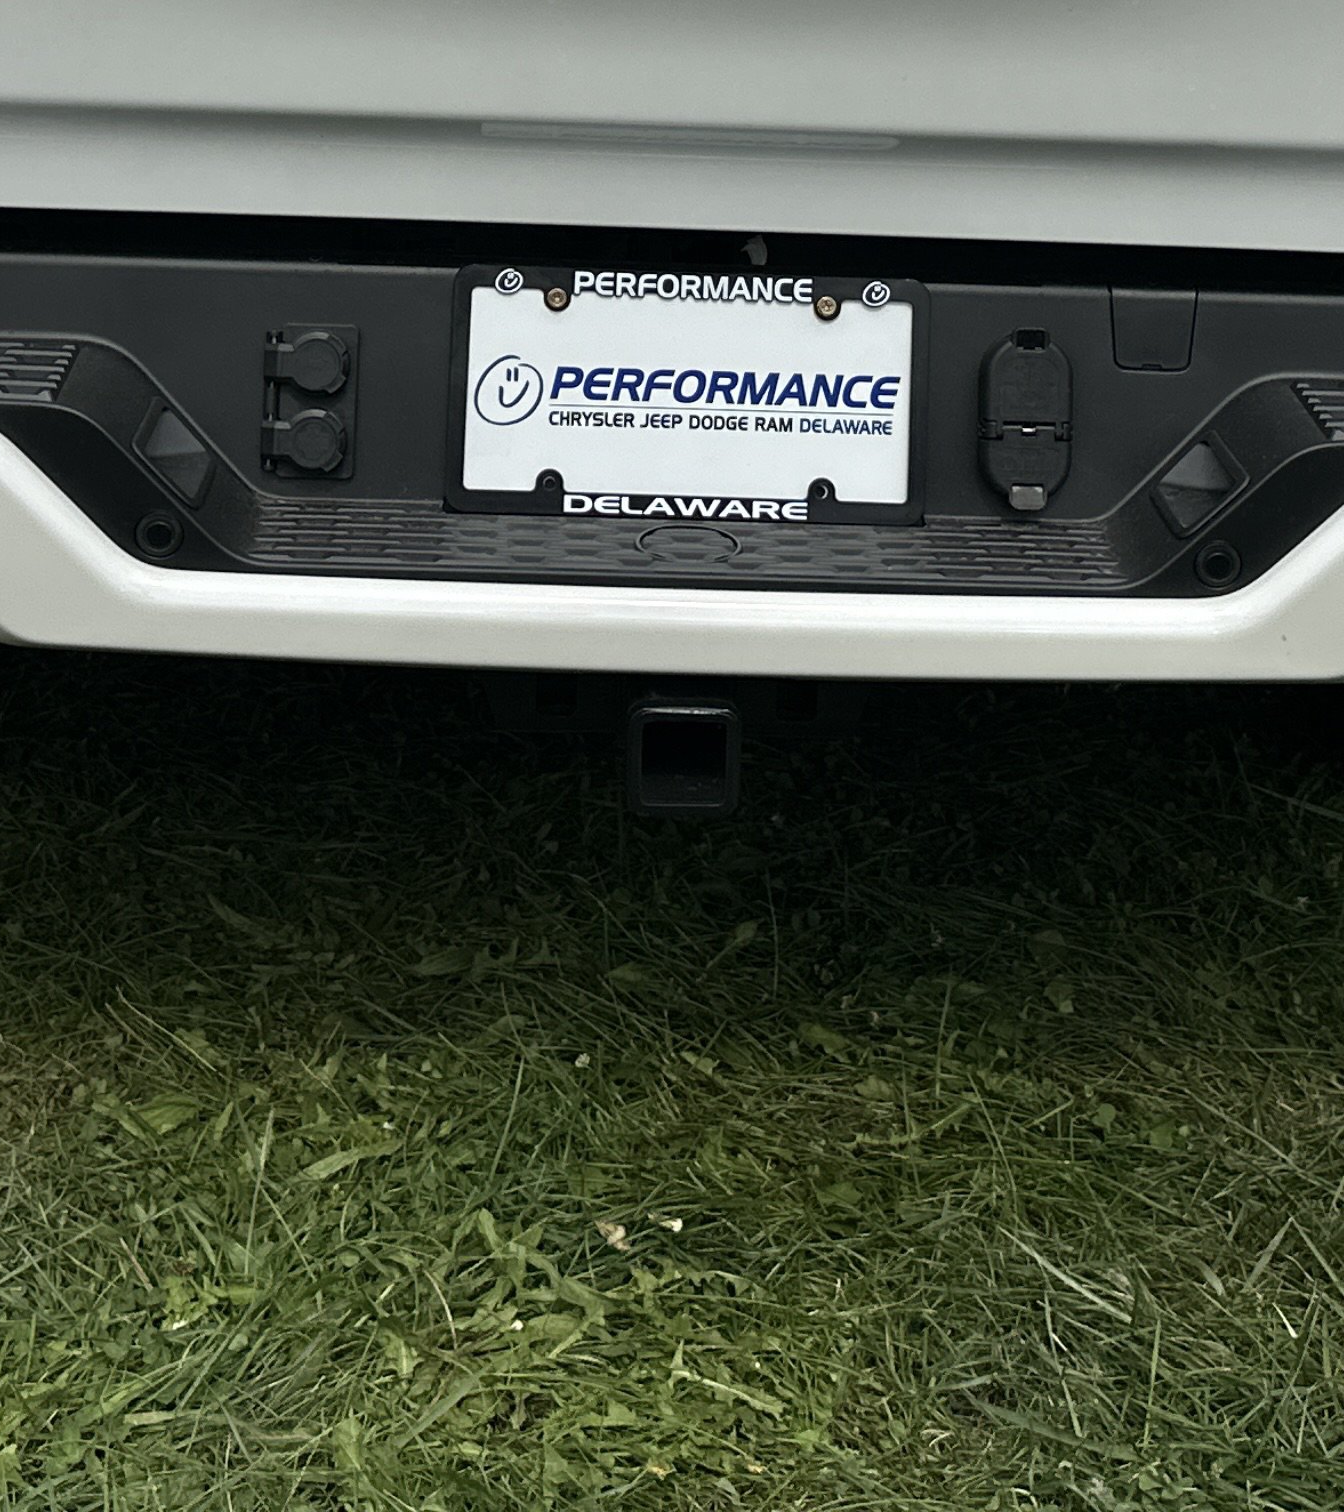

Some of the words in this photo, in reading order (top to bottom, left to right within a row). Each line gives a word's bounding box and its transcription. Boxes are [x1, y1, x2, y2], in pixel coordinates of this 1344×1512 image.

[573, 270, 814, 303] PERFORMANCE
[549, 366, 902, 409] PERFORMANCE
[548, 410, 635, 428] CHRYSLER
[639, 413, 683, 429] JEEP
[688, 414, 749, 432] DODGE
[754, 416, 794, 433] RAM
[799, 418, 894, 436] DELAWARE
[563, 494, 809, 521] DELAWARE
